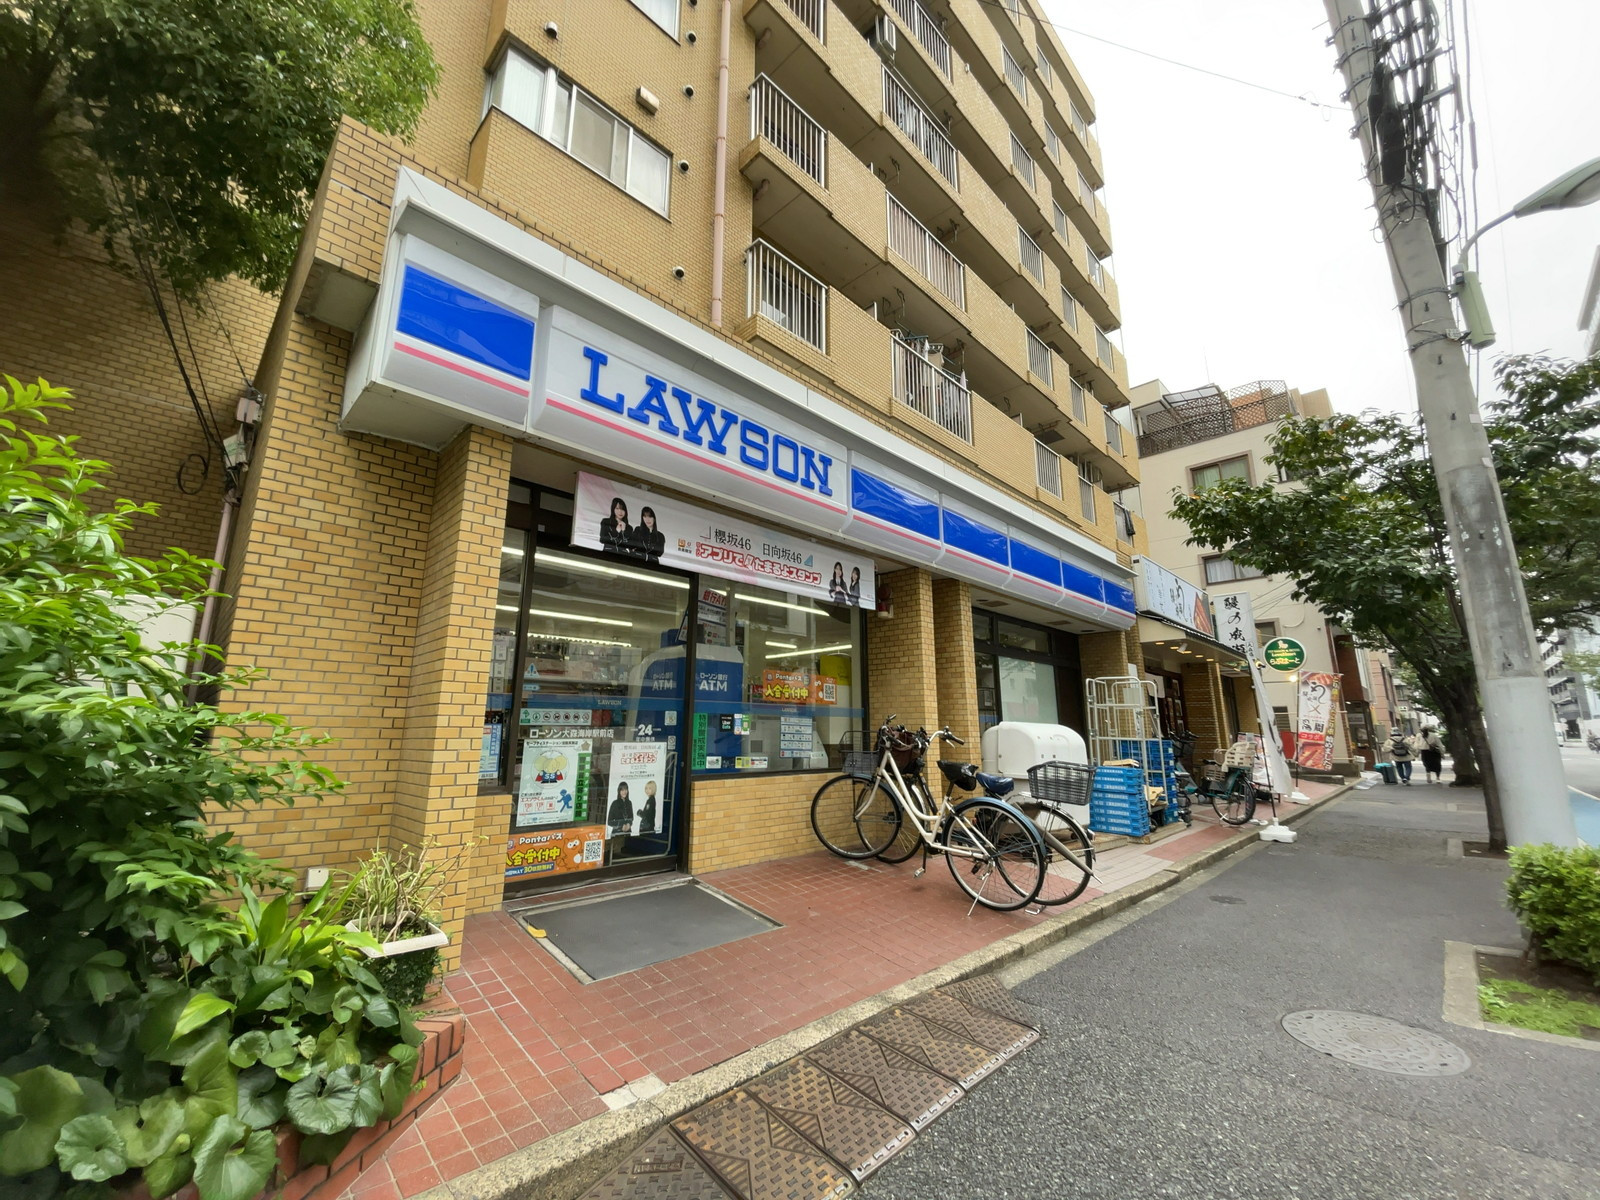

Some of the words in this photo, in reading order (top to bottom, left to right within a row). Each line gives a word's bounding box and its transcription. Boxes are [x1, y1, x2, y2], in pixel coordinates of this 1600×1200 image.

[581, 346, 832, 496] LAWSON
[714, 528, 751, 550] 櫻坂46
[762, 543, 802, 564] 日向坂46
[700, 672, 728, 680] ローソン銀行
[652, 679, 673, 691] ATM
[699, 680, 727, 691] ATM
[765, 684, 809, 699] 入会受付中
[529, 728, 614, 739] ローソン大森海岸駅前店
[638, 724, 653, 736] 24
[519, 833, 562, 844] Pontaパス
